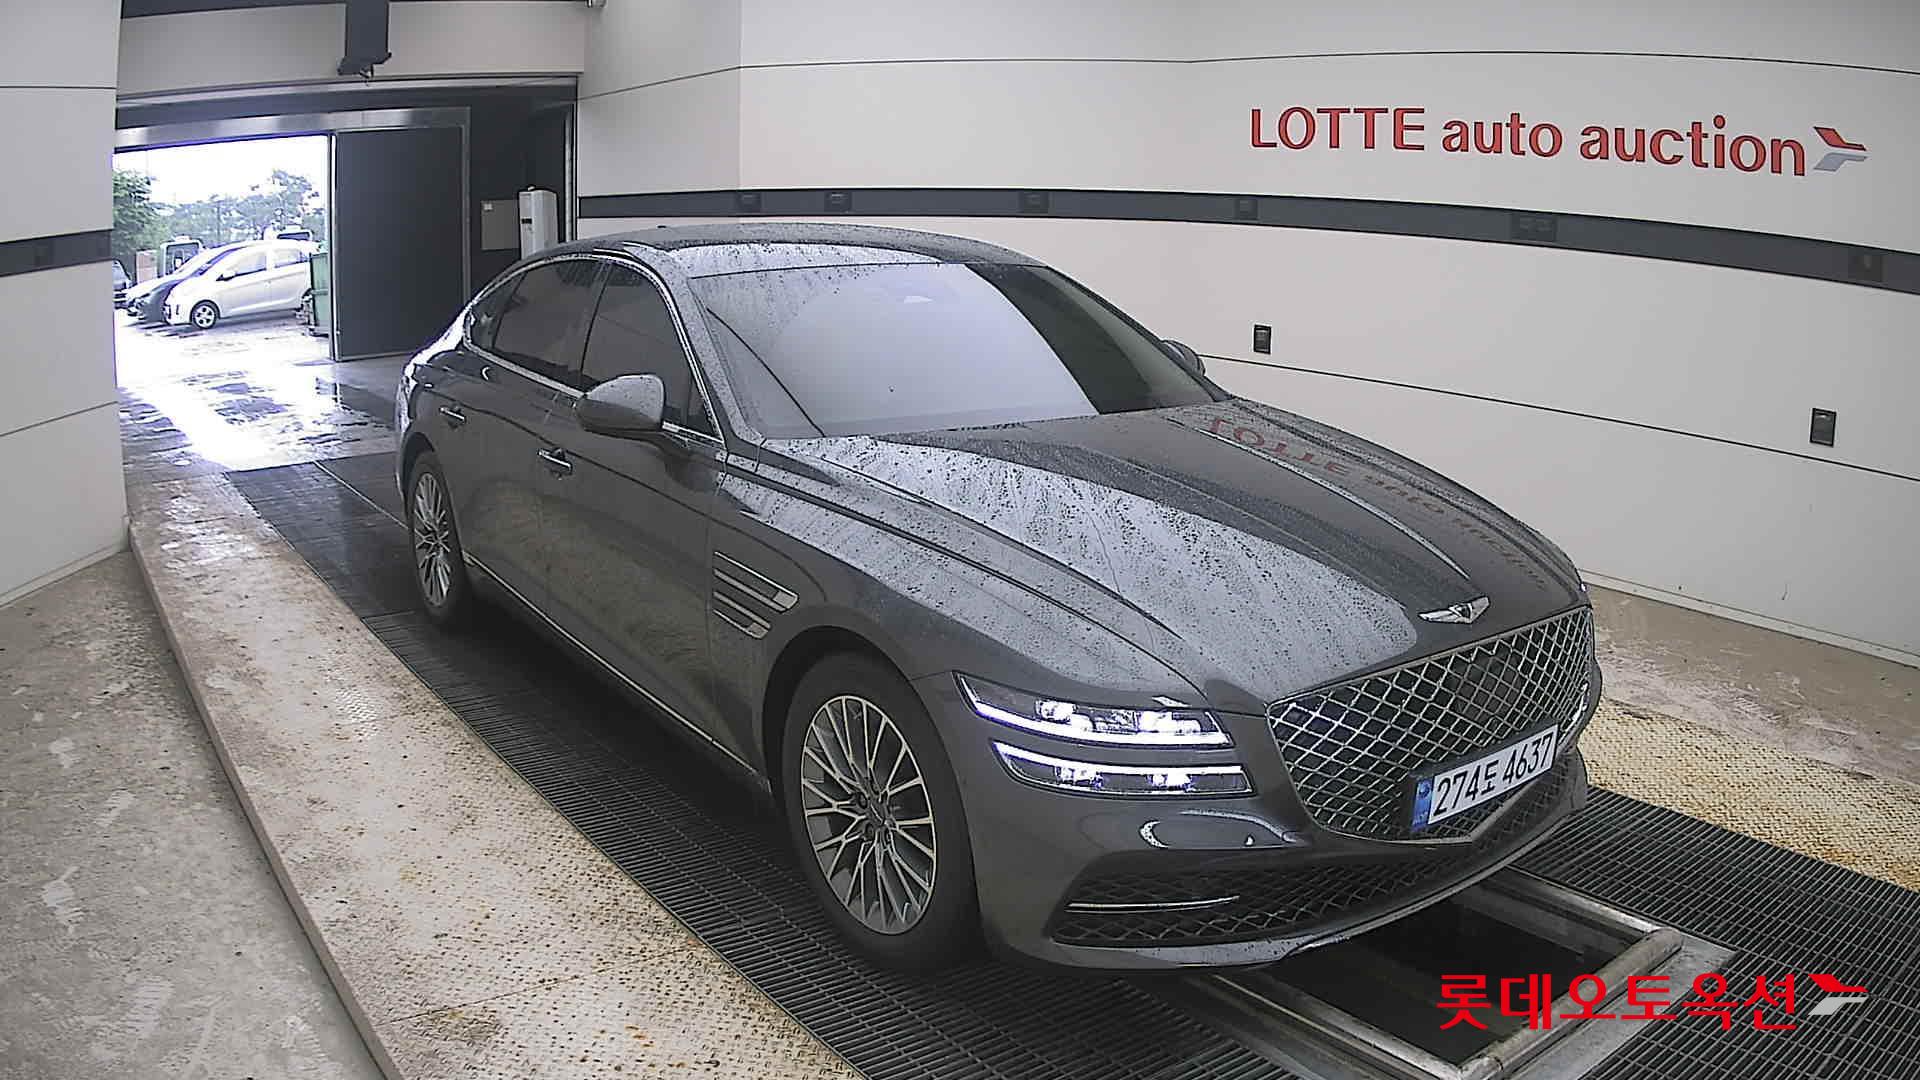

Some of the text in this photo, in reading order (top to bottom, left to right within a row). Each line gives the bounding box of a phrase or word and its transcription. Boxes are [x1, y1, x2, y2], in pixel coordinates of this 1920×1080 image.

[1251, 107, 1806, 177] LOTTE auto auction
[1502, 732, 1554, 785] 4637
